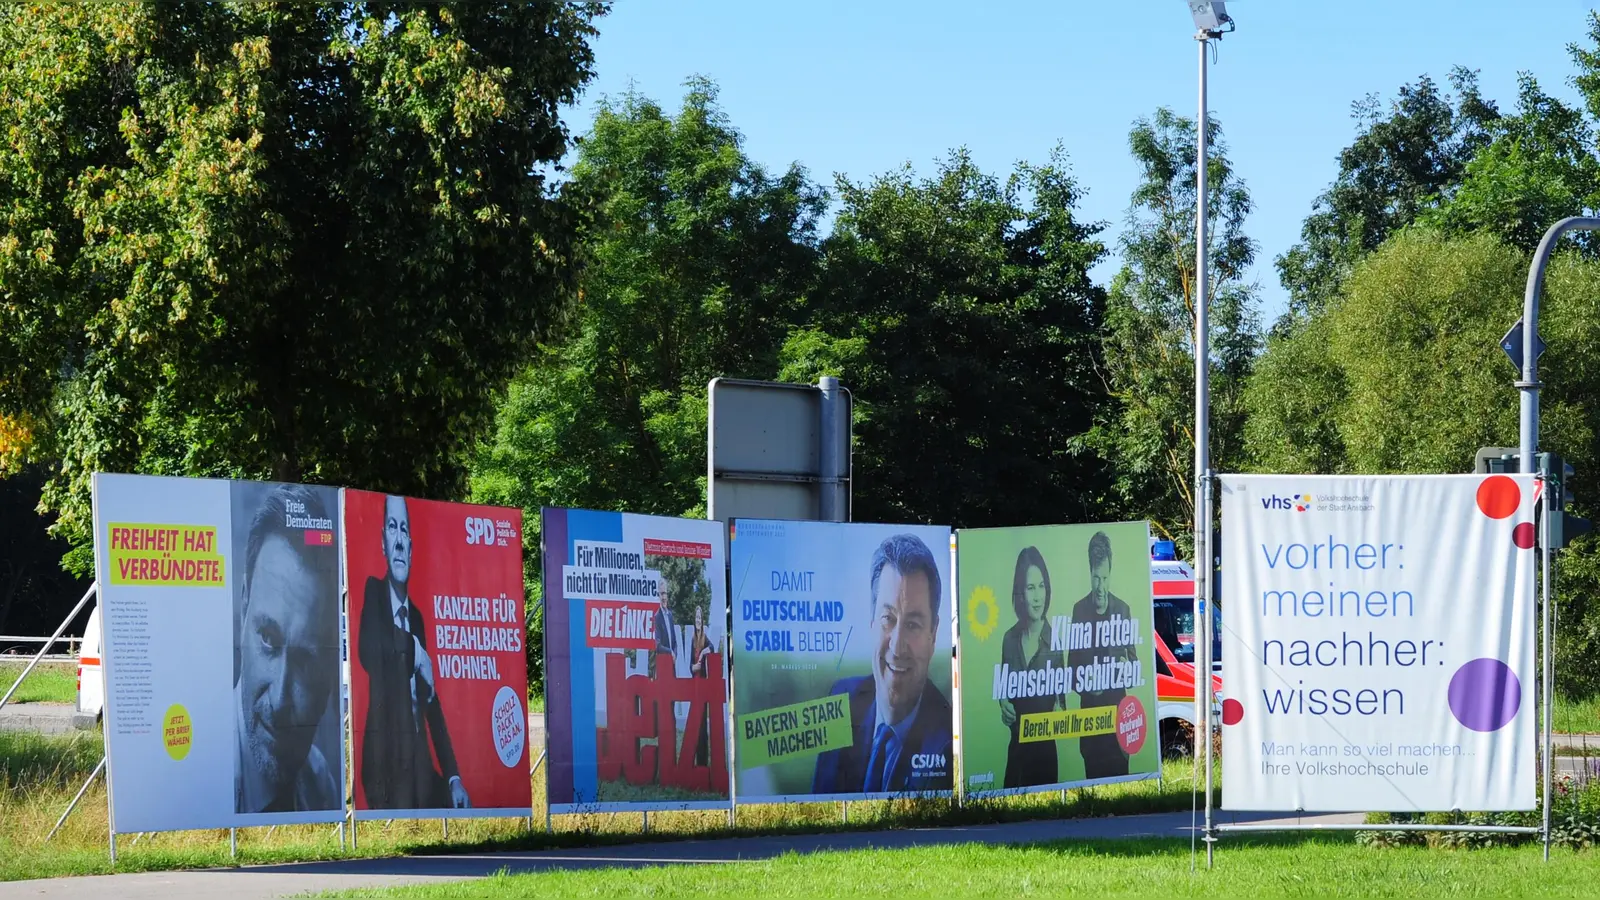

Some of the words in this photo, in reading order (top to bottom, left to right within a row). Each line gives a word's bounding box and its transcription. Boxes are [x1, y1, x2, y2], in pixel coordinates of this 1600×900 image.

[286, 499, 304, 513] Freie
[1261, 494, 1292, 510] vhs
[1316, 494, 1370, 502] Volkshochschule
[1316, 503, 1326, 512] der
[1329, 503, 1346, 512] Stadt
[1347, 503, 1375, 512] Ansbach
[286, 514, 332, 530] Demokraten
[465, 516, 495, 546] SPD
[496, 520, 510, 528] Soziale
[496, 528, 510, 538] Politik
[111, 527, 180, 552] FREIHEIT
[184, 530, 214, 552] HAT
[320, 533, 332, 543] FDP
[577, 545, 594, 567] Für
[594, 547, 644, 573] Millionen,
[1261, 534, 1404, 570] vorher:
[118, 552, 222, 582] VERBÜNDETE.
[566, 574, 592, 594] nicht
[594, 572, 608, 595] für
[608, 576, 660, 598] Millionäre.
[771, 570, 814, 592] DAMIT
[434, 595, 490, 622] KANZLER
[493, 593, 517, 623] FÜR
[742, 600, 844, 622] DEUTSCHLAND
[1263, 582, 1414, 617] meinen
[590, 606, 614, 638] DIE
[1050, 615, 1092, 651] Klima
[1095, 614, 1144, 648] retten.
[436, 624, 522, 653] BEZAHLBARES
[745, 630, 794, 652] STABIL
[798, 632, 842, 652] BLEIBT
[1263, 631, 1444, 666] nachher:
[437, 654, 501, 680] WOHNEN.
[992, 660, 1073, 700] Menschen
[1076, 656, 1146, 693] schützen.
[494, 695, 516, 723] SCHOLZ
[1262, 680, 1404, 715] wissen
[165, 728, 176, 737] PER
[176, 726, 190, 735] BRIEF
[170, 715, 184, 725] JETZT
[497, 712, 515, 736] PACKT
[744, 710, 798, 739] BAYERN
[802, 699, 844, 726] STARK
[1023, 718, 1052, 738] Bereit,
[1052, 714, 1070, 736] weil
[1071, 714, 1082, 733] Ihr
[1084, 716, 1094, 731] es
[1096, 710, 1114, 730] seid.
[1120, 714, 1142, 734] Briefwahl
[167, 736, 190, 748] WÄHLEN
[500, 730, 512, 750] DAS
[512, 722, 522, 739] AN.
[767, 726, 828, 758] MACHEN!
[912, 753, 935, 769] CSU
[1261, 742, 1294, 756] Man
[1300, 742, 1338, 756] kann
[1343, 745, 1362, 756] so
[1366, 742, 1392, 756] viel
[1261, 761, 1291, 776] Ihre
[1296, 761, 1429, 776] Volkshochschule
